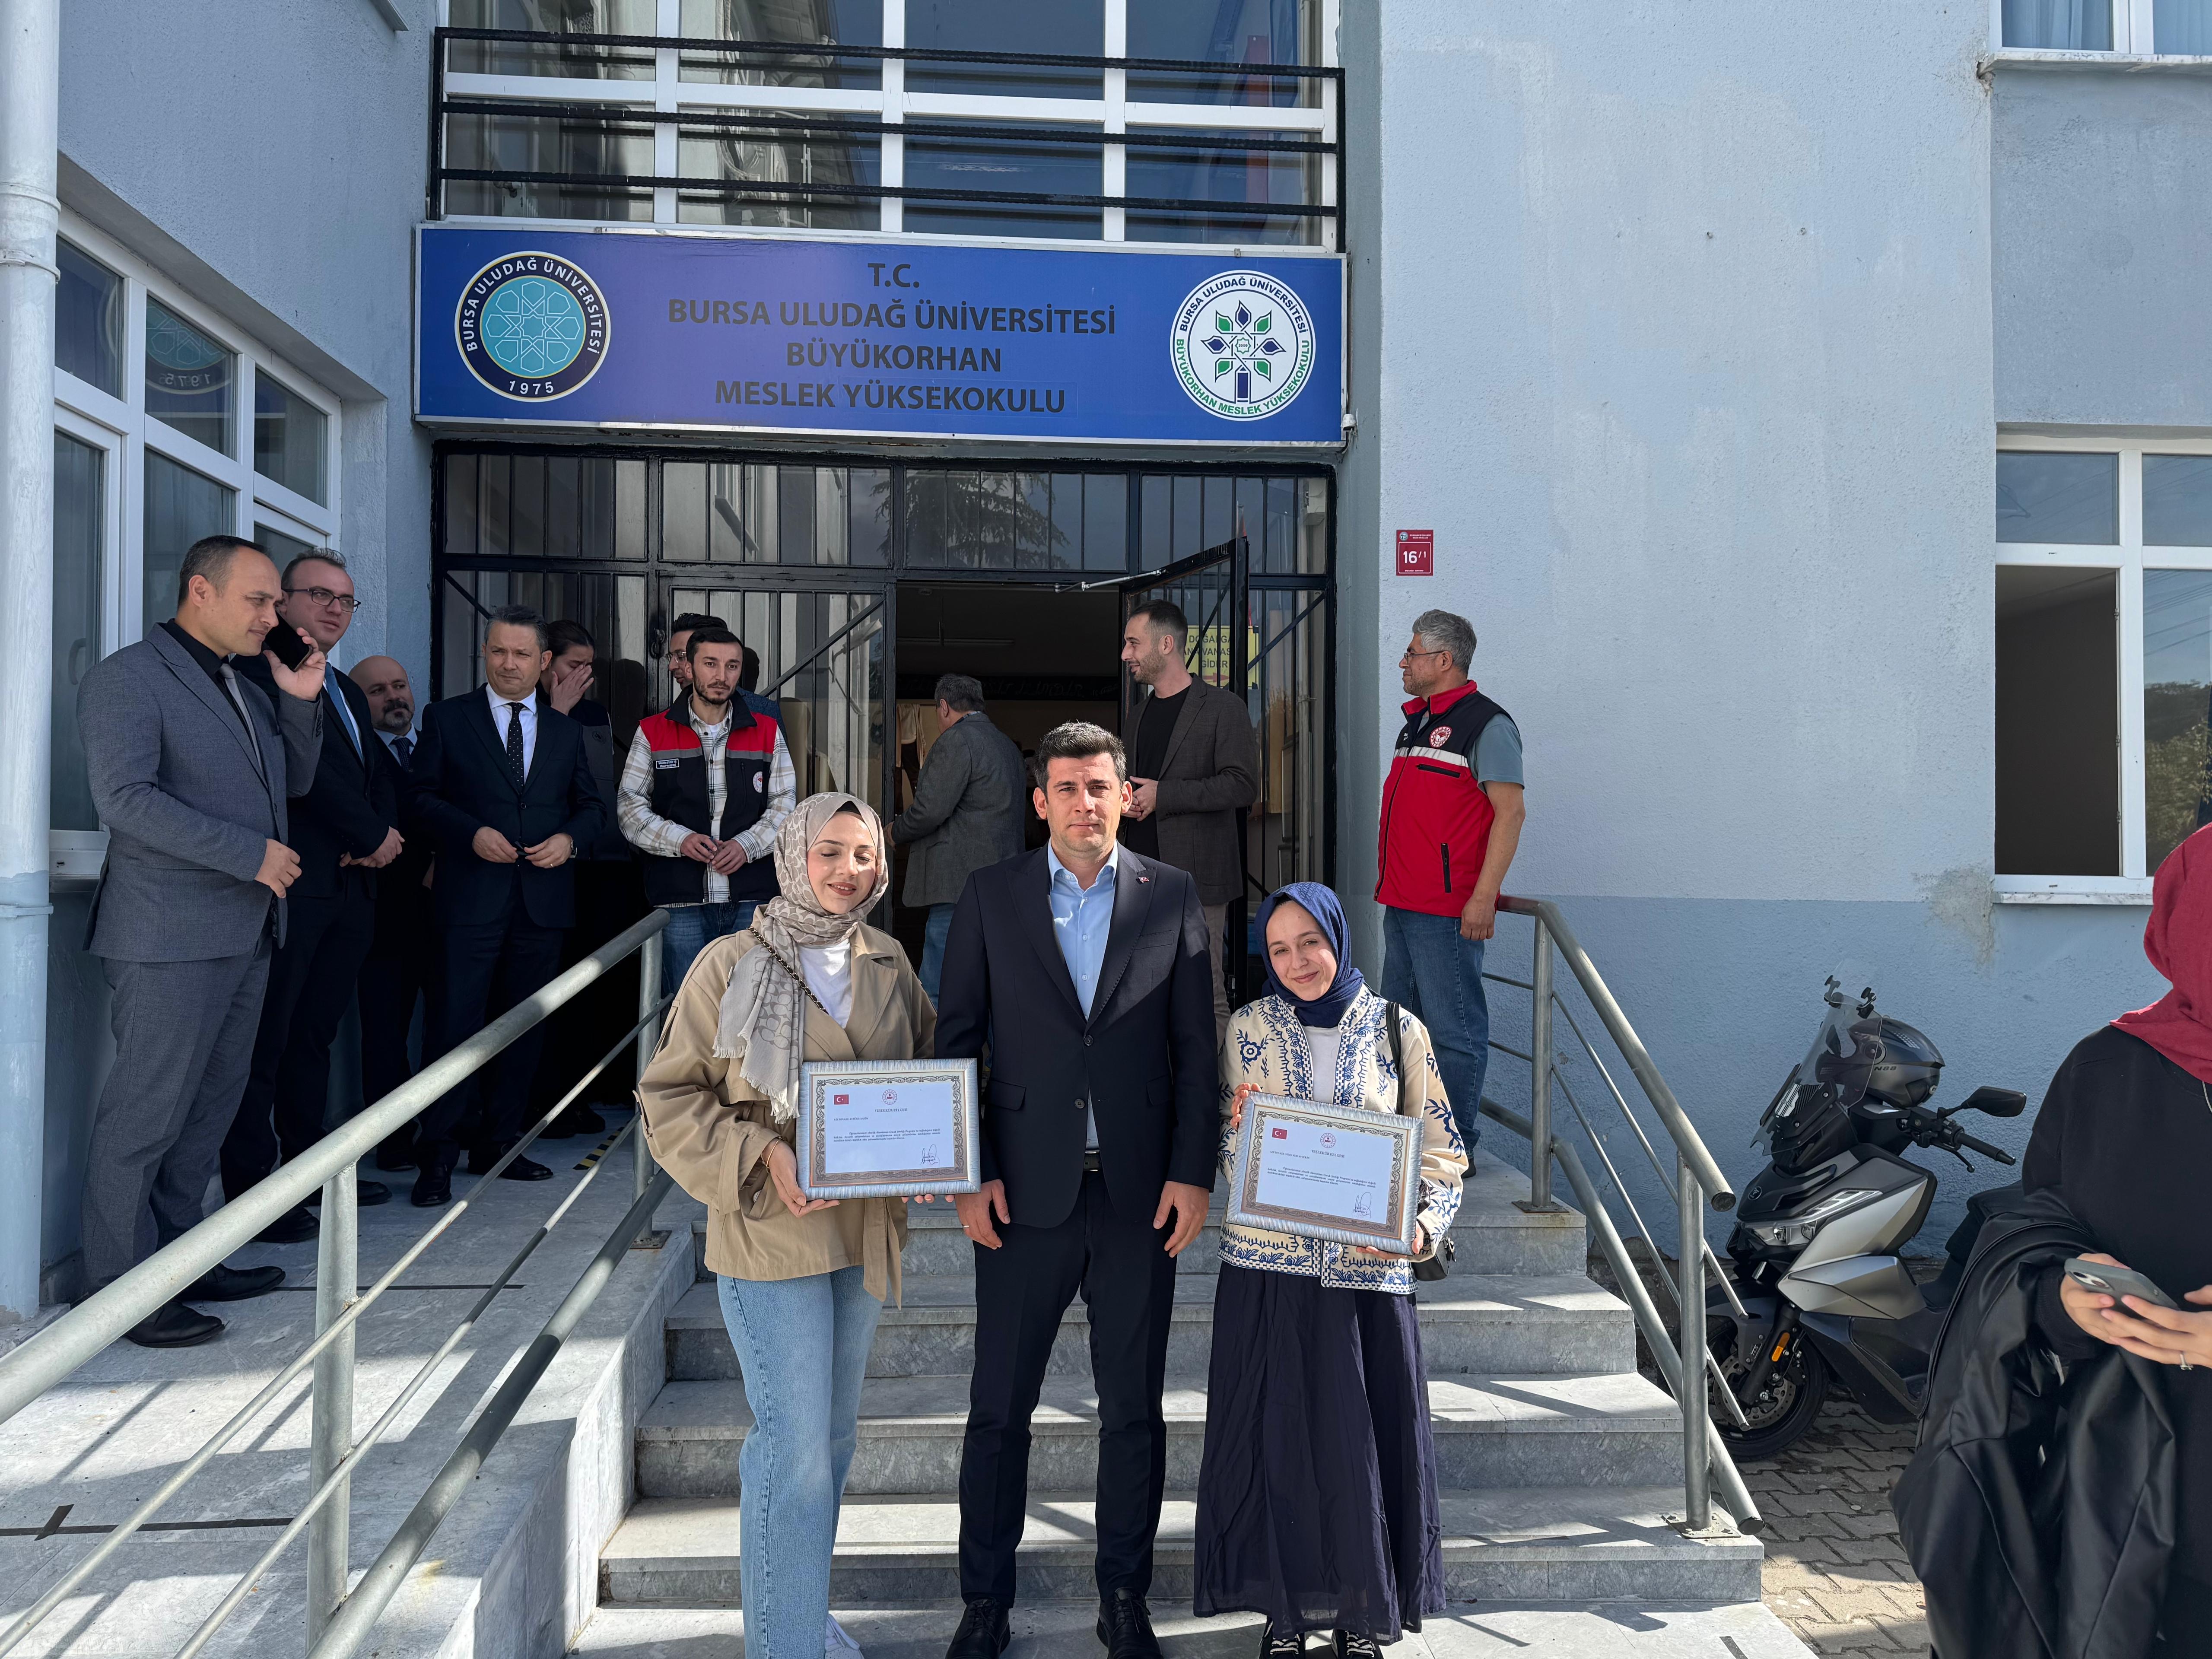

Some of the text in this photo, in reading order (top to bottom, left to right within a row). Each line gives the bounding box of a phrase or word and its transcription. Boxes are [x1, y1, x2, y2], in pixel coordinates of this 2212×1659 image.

[868, 263, 920, 288] T.C.
[463, 257, 603, 354] BURSA ULUDAĞ ÜNİVERSİTESİ
[668, 298, 1115, 334] BURSA ULUDAĞ ÜNİVERSİTESİ
[1179, 276, 1309, 333] BURSA ULUDAĞ ÜNİVERSİTESİ
[787, 337, 1001, 372] BÜYÜKORHAN
[509, 380, 554, 395] 1975
[1176, 339, 1309, 415] BÜYÜKORHAN MESLEK YÜKSEKOKULU
[715, 379, 1065, 413] MESLEK YÜKSEKOKULU
